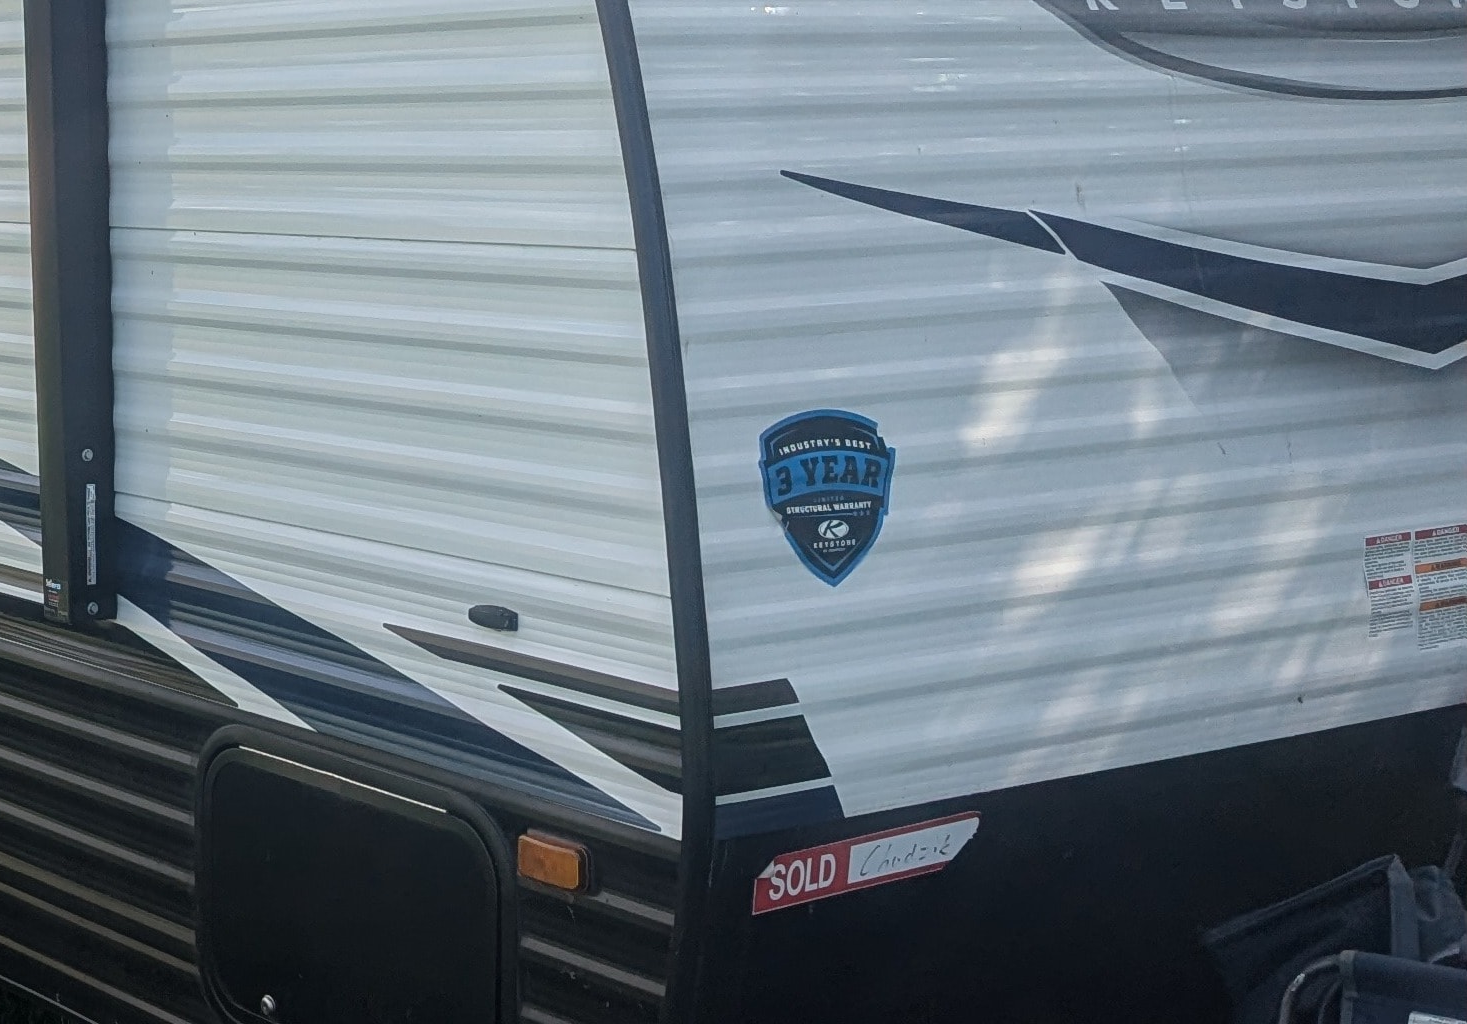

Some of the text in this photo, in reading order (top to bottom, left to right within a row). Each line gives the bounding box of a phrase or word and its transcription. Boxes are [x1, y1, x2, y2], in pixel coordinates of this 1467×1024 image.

[778, 438, 872, 456] INDUSTRY'S BEST
[775, 455, 882, 497] 3 YEAR
[786, 500, 872, 515] STRUCTURAL WARRANTY
[813, 538, 856, 549] KEYSTONE
[768, 853, 836, 901] SOLD
